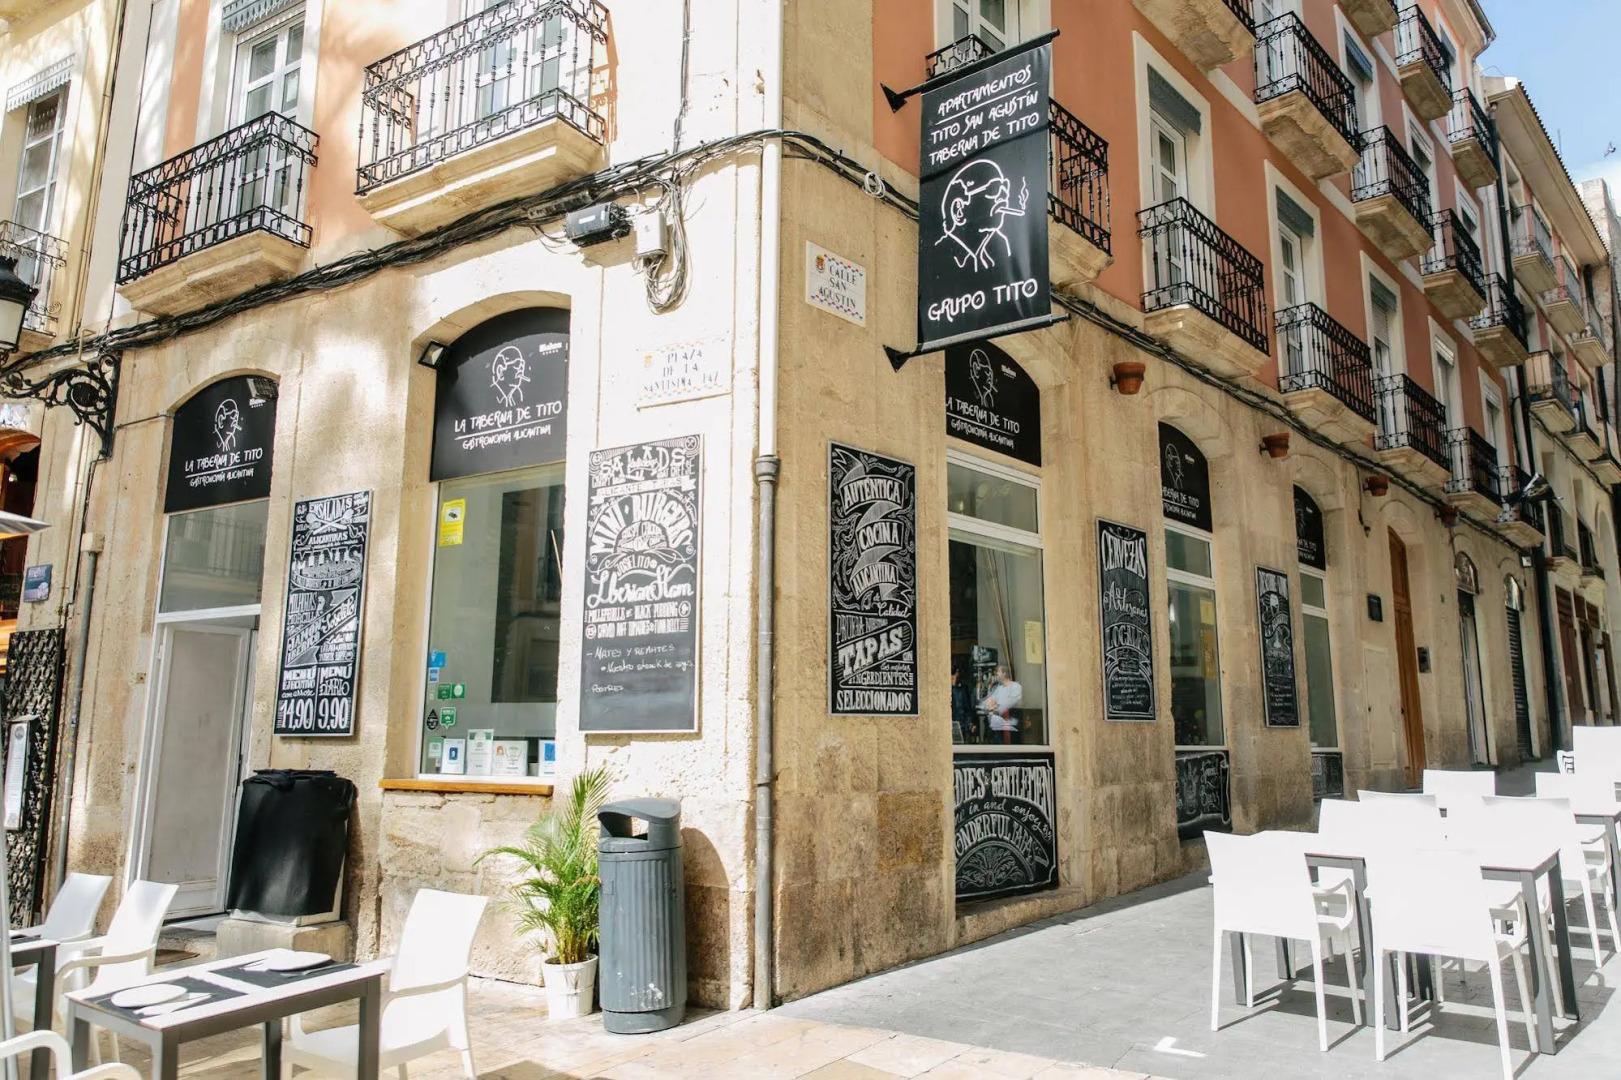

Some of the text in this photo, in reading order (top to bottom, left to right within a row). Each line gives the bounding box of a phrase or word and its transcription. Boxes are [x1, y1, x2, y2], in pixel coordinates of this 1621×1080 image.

[937, 64, 1032, 117] APARTAMENTOS
[931, 91, 1039, 145] TITO SAN AGUSTÍN
[929, 112, 1040, 166] TABERNA DE TITO
[829, 265, 857, 286] CALLE
[829, 277, 847, 292] SAN
[927, 278, 1039, 323] GRUPO TITO
[454, 400, 563, 433] LA TABERNA DE TITO
[946, 396, 1020, 434] A TABERNA DE TITO
[513, 424, 552, 441] ALICANTINA
[184, 447, 263, 473] LA TABERNA DE TITO
[600, 445, 687, 482] SALADS
[590, 498, 627, 555] MINI
[631, 492, 693, 548] BURGERS
[859, 522, 901, 551] COCINA
[292, 545, 363, 572] MINIS
[615, 554, 651, 577] JOSELITO
[1101, 530, 1147, 581] CERVEZAS
[851, 562, 898, 600] ALICANTINA
[877, 601, 912, 618] Calidad
[836, 614, 864, 645] PRUEBA
[838, 626, 903, 679] TAPAS
[283, 665, 317, 681] MENÚ
[319, 678, 350, 697] DIARIO
[320, 662, 353, 683] MENÚ
[835, 690, 912, 712] SELECCIONADOS
[954, 766, 986, 810] DIES
[991, 766, 1053, 829] GENTLEMEN
[968, 802, 981, 815] in
[983, 798, 1007, 812] and
[1012, 805, 1044, 833] enjoy
[955, 814, 1011, 866] ONDERFUL
